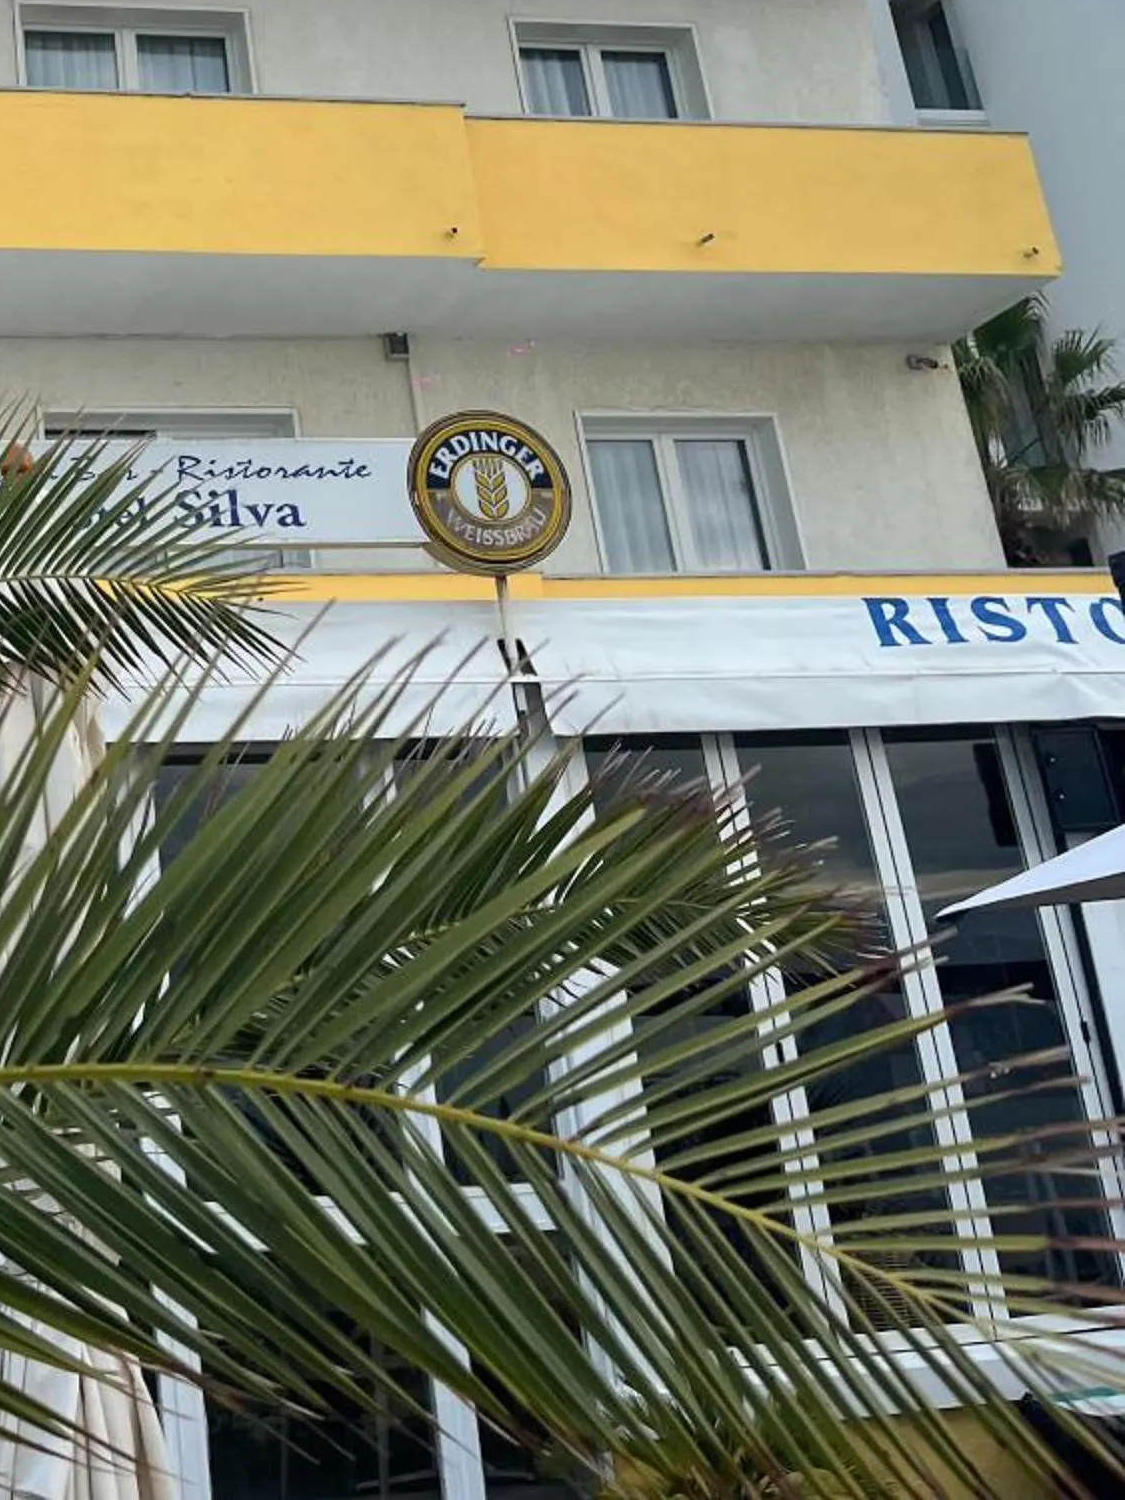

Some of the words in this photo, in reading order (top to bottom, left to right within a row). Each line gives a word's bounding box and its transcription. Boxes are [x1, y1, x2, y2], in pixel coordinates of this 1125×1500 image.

[177, 455, 371, 480] Ristorante
[428, 431, 544, 480] ERDINGER
[176, 488, 307, 528] Silva
